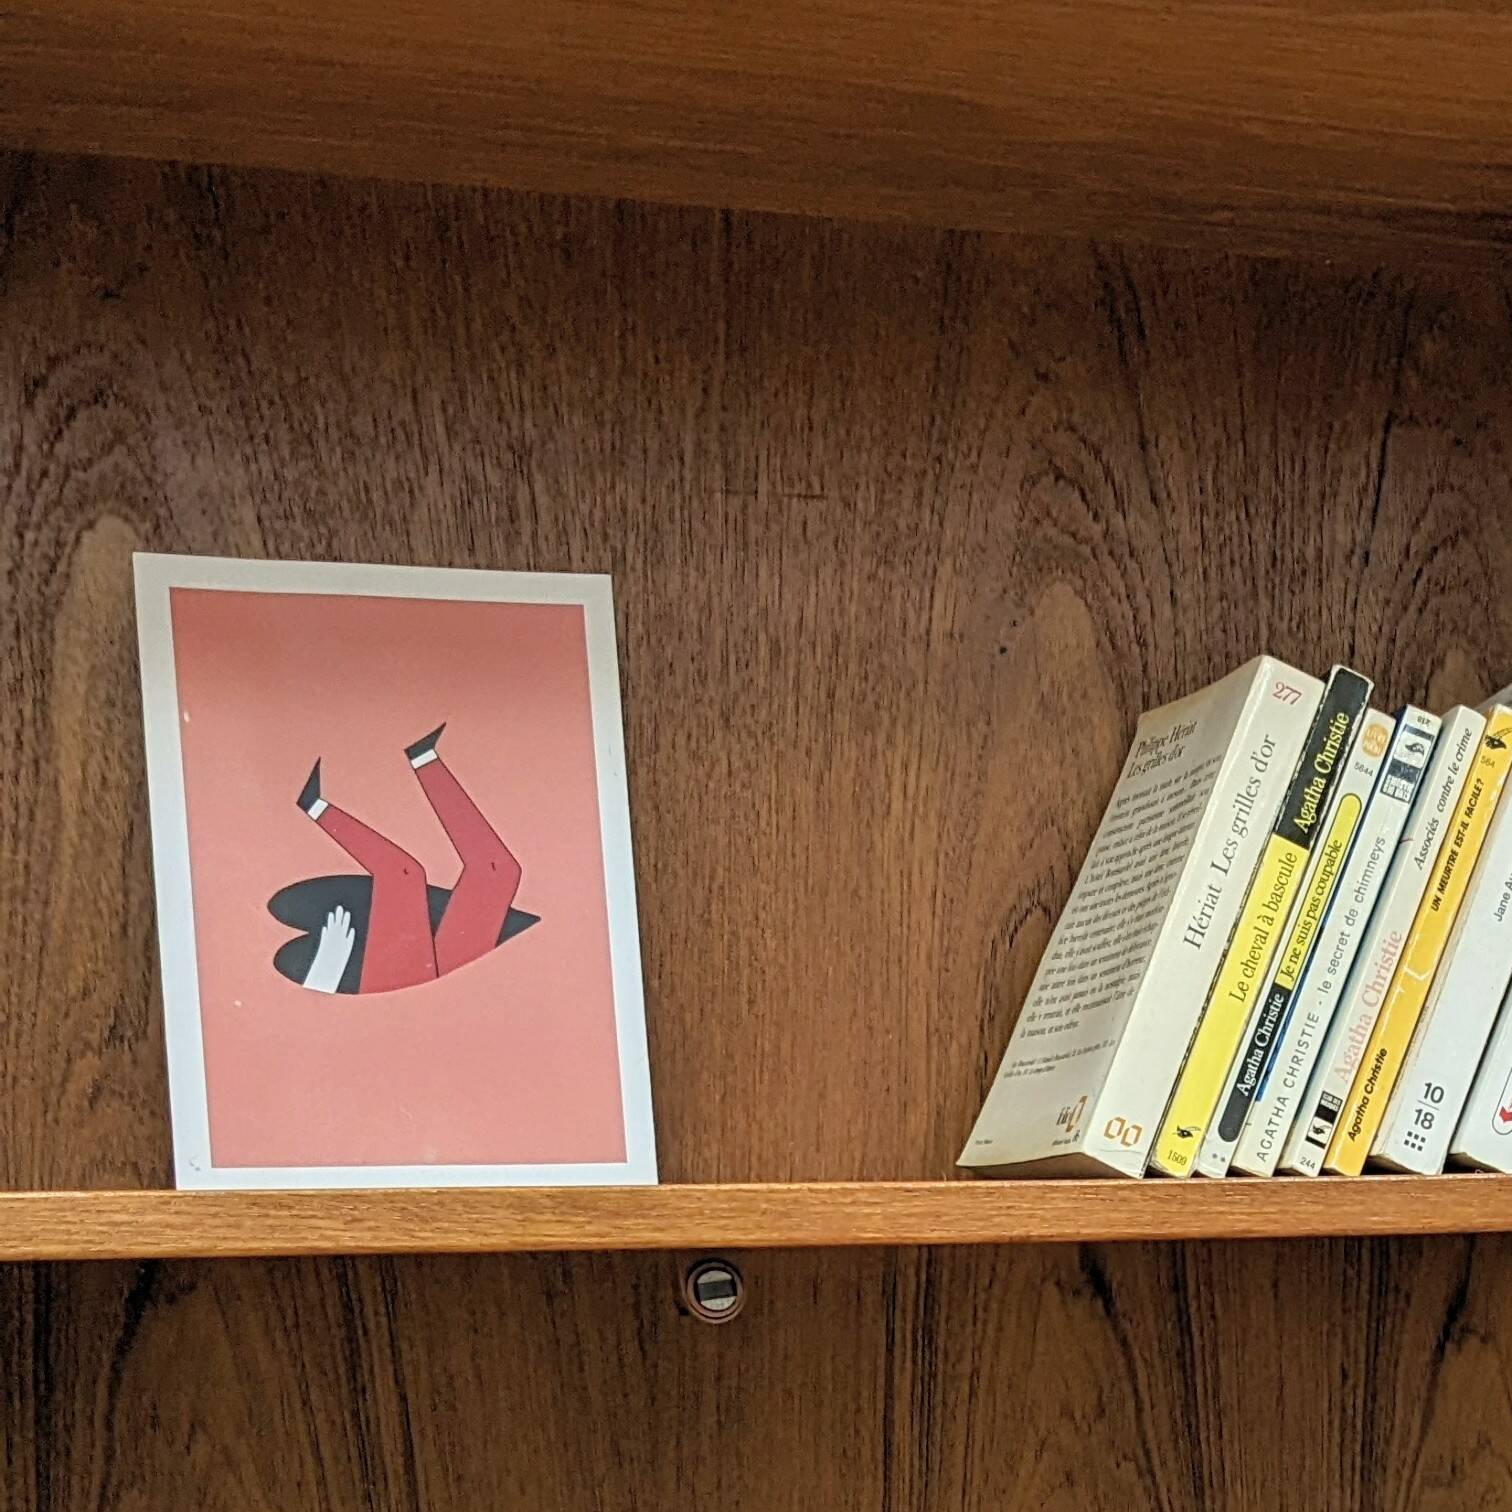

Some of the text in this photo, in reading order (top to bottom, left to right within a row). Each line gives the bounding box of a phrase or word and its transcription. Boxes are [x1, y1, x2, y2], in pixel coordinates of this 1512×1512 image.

[1272, 681, 1303, 705] 277
[1292, 711, 1350, 834] Agatha Christie
[1414, 728, 1473, 871] Associés contre le crime
[1183, 733, 1276, 951] Hériat Les grilles d'or
[1430, 895, 1442, 913] UN
[1436, 848, 1459, 896] MEURTRE
[1455, 821, 1470, 849] EST-IL
[1229, 852, 1298, 1004] Le cheval à bascule
[1279, 839, 1343, 982] Je ne suis pas coupable
[1496, 891, 1512, 923] Jane
[1236, 992, 1285, 1097] Agatha Christie
[1256, 1095, 1290, 1163] AGATHA
[1282, 1014, 1320, 1089] CHRISTIE
[1317, 980, 1332, 995] le
[1327, 931, 1350, 977] secret
[1345, 908, 1359, 928] de
[1354, 836, 1386, 904] chimneys
[1334, 930, 1402, 1083] Agatha Christie
[1348, 1048, 1388, 1142] Agatha Christie
[1414, 1108, 1435, 1130] 18
[1423, 1082, 1445, 1104] 10
[1300, 1157, 1316, 1170] 244
